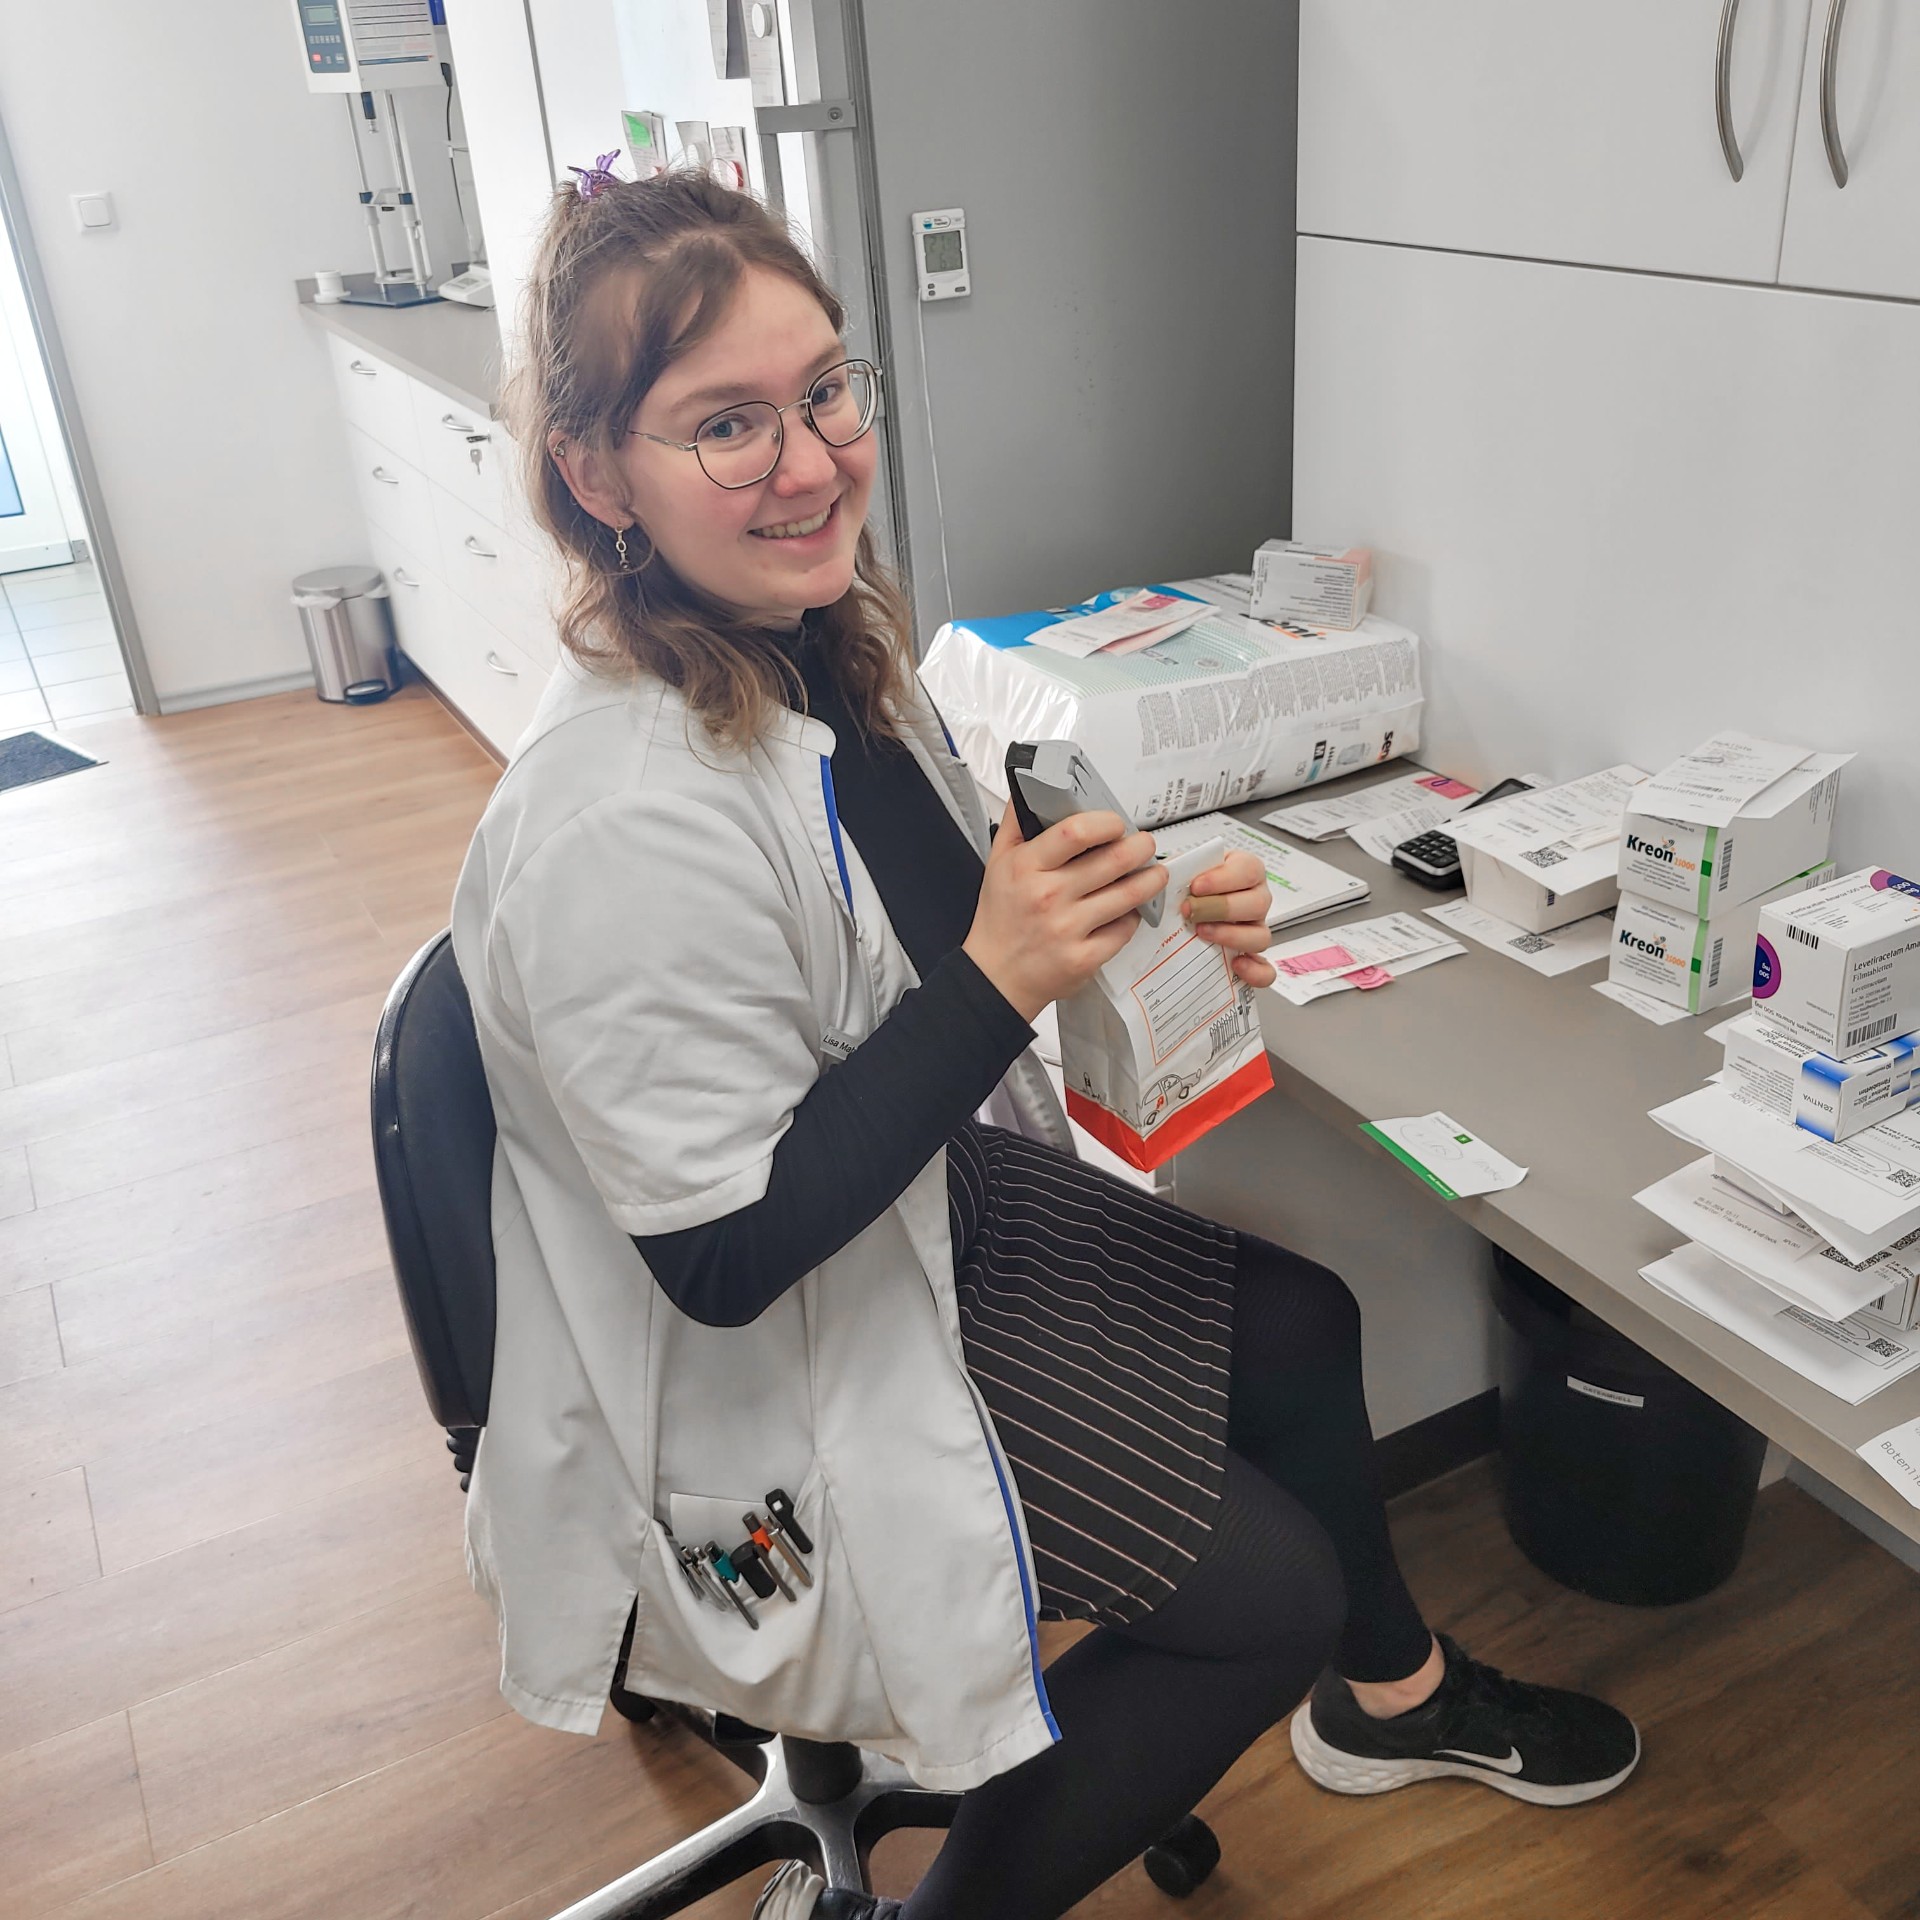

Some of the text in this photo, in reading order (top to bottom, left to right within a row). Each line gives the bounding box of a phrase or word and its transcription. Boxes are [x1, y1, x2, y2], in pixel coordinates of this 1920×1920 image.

[1627, 834, 1674, 863] Kreon
[1619, 929, 1665, 959] Kreon
[1852, 962, 1893, 982] Filmtabletten
[1853, 946, 1904, 972] Levetiracetam
[823, 1034, 840, 1048] Lisa
